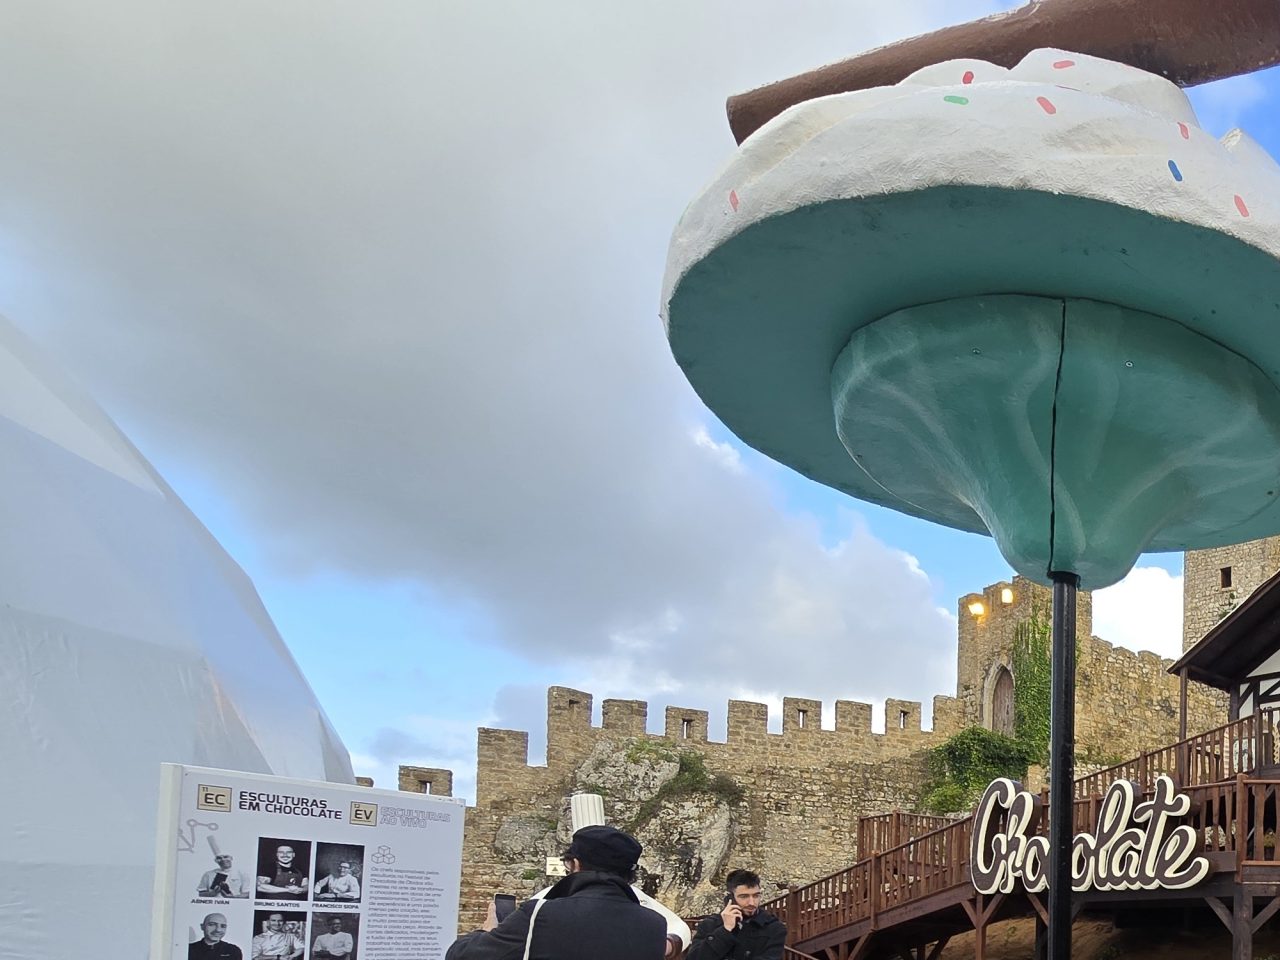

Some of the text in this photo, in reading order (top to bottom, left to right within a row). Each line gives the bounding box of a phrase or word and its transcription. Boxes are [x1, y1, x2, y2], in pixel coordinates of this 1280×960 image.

[205, 793, 226, 805] EC
[239, 791, 327, 809] ESCULTURAS
[239, 801, 342, 820] EM CHOCOLATE
[355, 809, 373, 820] EV
[381, 807, 451, 822] ESCULTURAS
[380, 815, 397, 825] AO
[401, 817, 427, 828] VIVO
[970, 775, 1209, 894] Choolate
